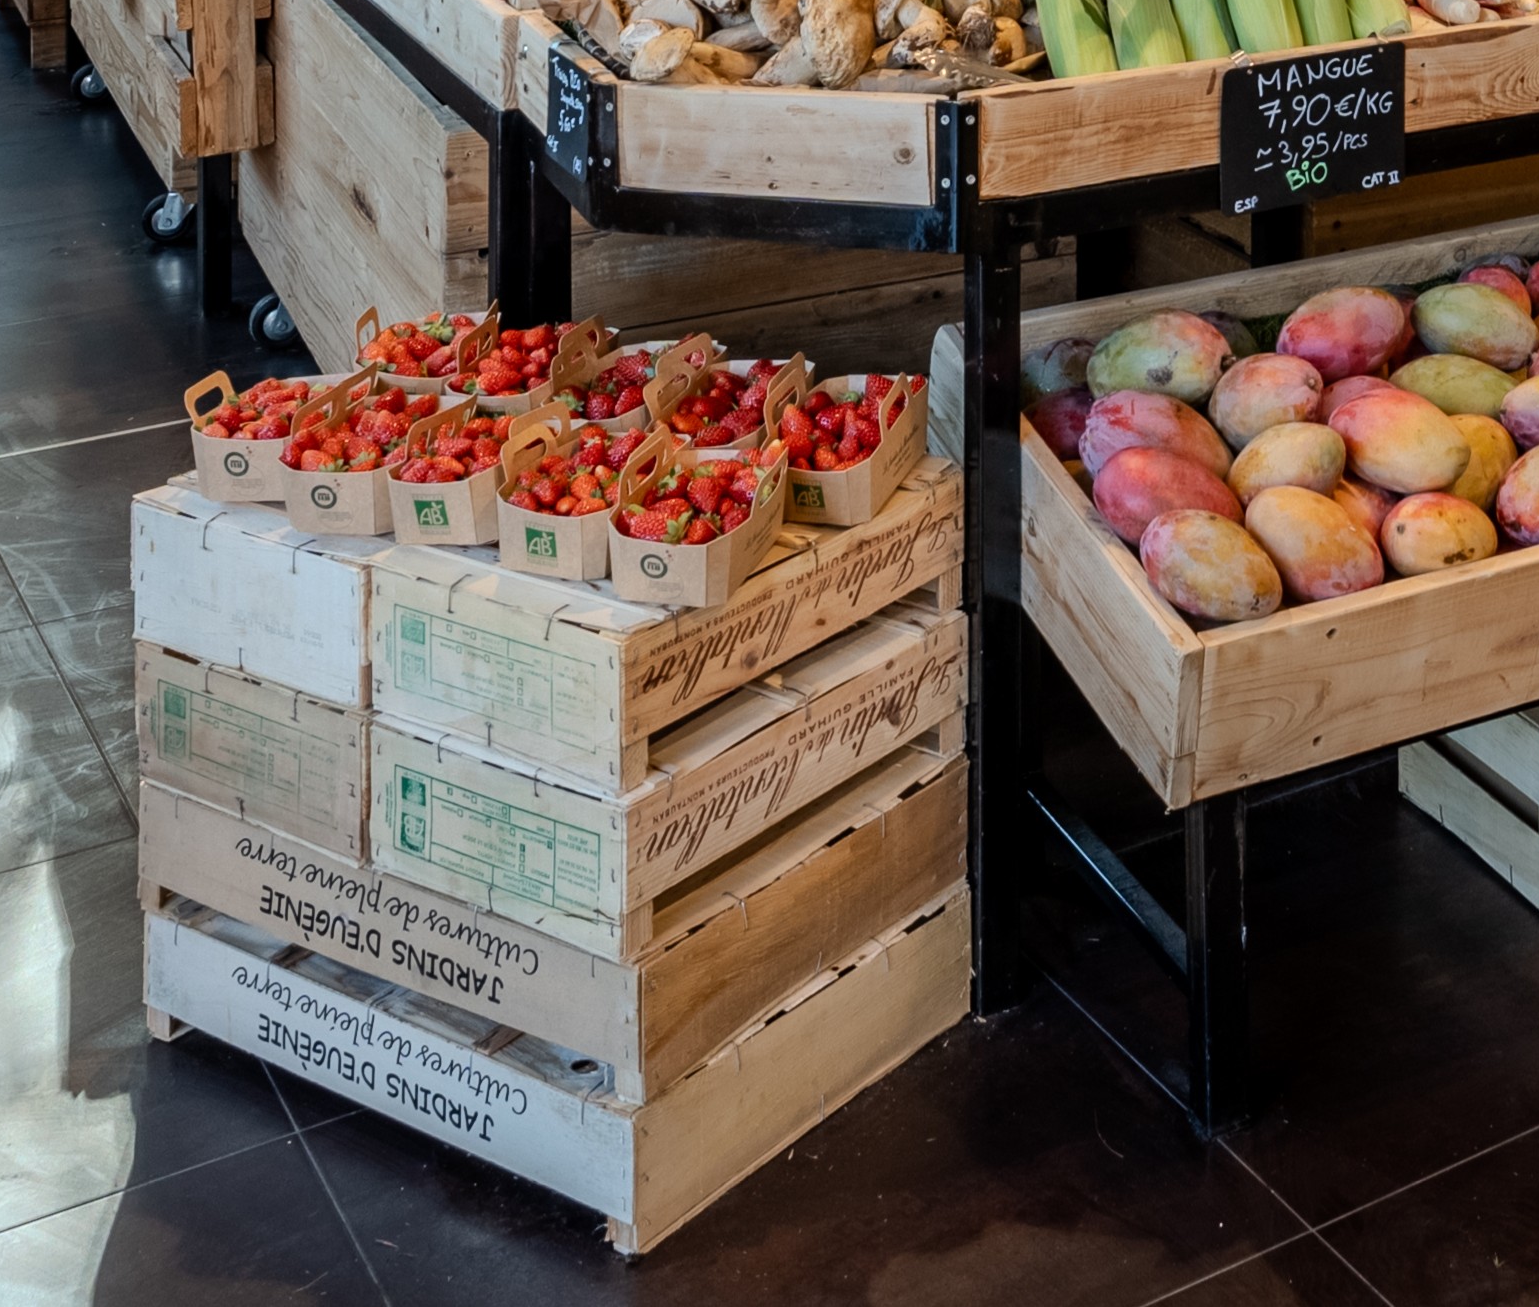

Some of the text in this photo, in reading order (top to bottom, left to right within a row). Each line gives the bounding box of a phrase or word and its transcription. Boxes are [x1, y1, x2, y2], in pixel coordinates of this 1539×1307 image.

[1257, 53, 1373, 98] MANGUE
[1361, 170, 1400, 188] CAT II
[1234, 195, 1259, 214] ESP
[419, 506, 445, 526] AB
[528, 537, 553, 556] AB
[784, 521, 911, 590] FAMILLE GUIHARD
[836, 511, 933, 608] Jardin
[712, 591, 773, 624] PRODUCTEURS
[648, 625, 703, 658] MONTAUBAN
[788, 666, 914, 746] FAMILLE GUIHARD
[837, 657, 936, 758] Jardin
[715, 747, 776, 787] PRODUCTEURS
[651, 789, 706, 825] MONTAUBAN
[234, 838, 539, 976] Cultures de pleine terre
[259, 885, 504, 1005] JARDINS D'EUGÈNIE
[231, 965, 528, 1116] Cultures de pleine terre
[257, 1014, 495, 1142] JARDINS D'EUGÈNIE
